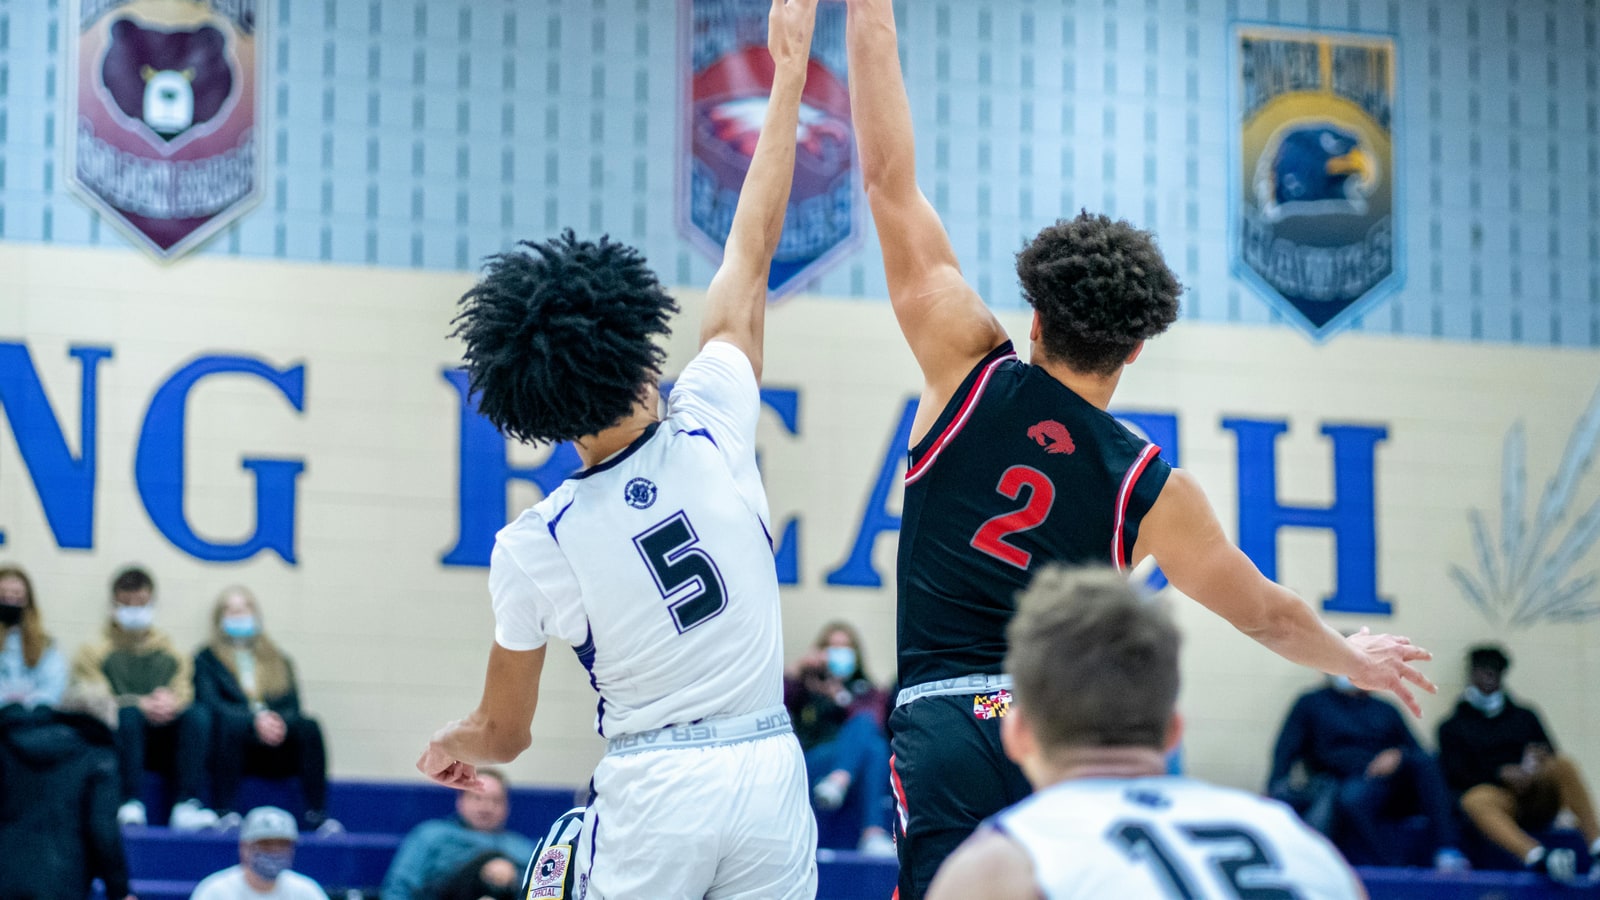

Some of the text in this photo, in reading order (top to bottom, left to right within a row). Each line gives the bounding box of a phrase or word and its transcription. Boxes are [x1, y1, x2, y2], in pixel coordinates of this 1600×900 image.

[970, 464, 1056, 571] 2
[632, 509, 729, 635] 5
[1103, 819, 1312, 900] 12
